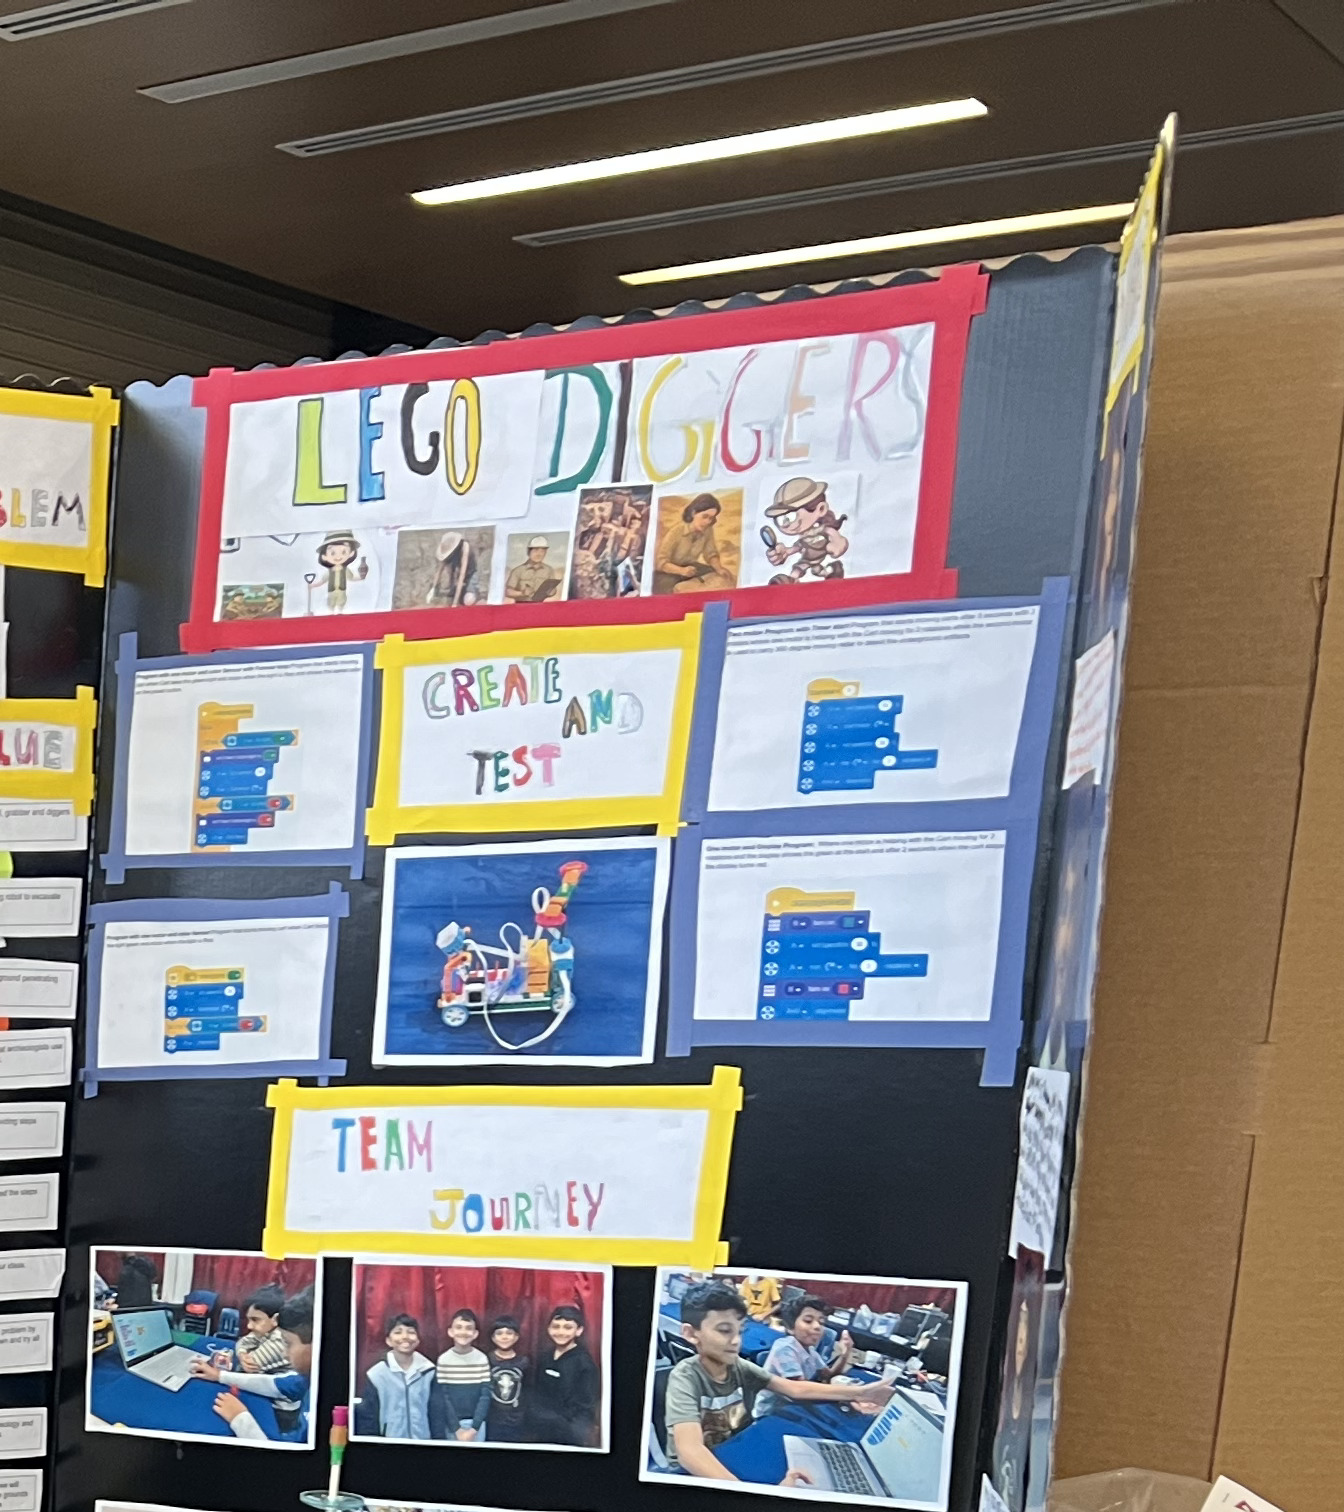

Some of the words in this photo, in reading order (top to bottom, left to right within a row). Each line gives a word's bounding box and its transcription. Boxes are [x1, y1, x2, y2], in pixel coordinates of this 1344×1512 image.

[292, 377, 483, 507] LEGO
[534, 327, 928, 497] DIGGERS
[422, 656, 562, 720] CREATE
[562, 687, 645, 739] AND
[466, 743, 561, 795] TEST
[331, 1115, 433, 1173] TEAM
[429, 1181, 605, 1234] JOURNEY
